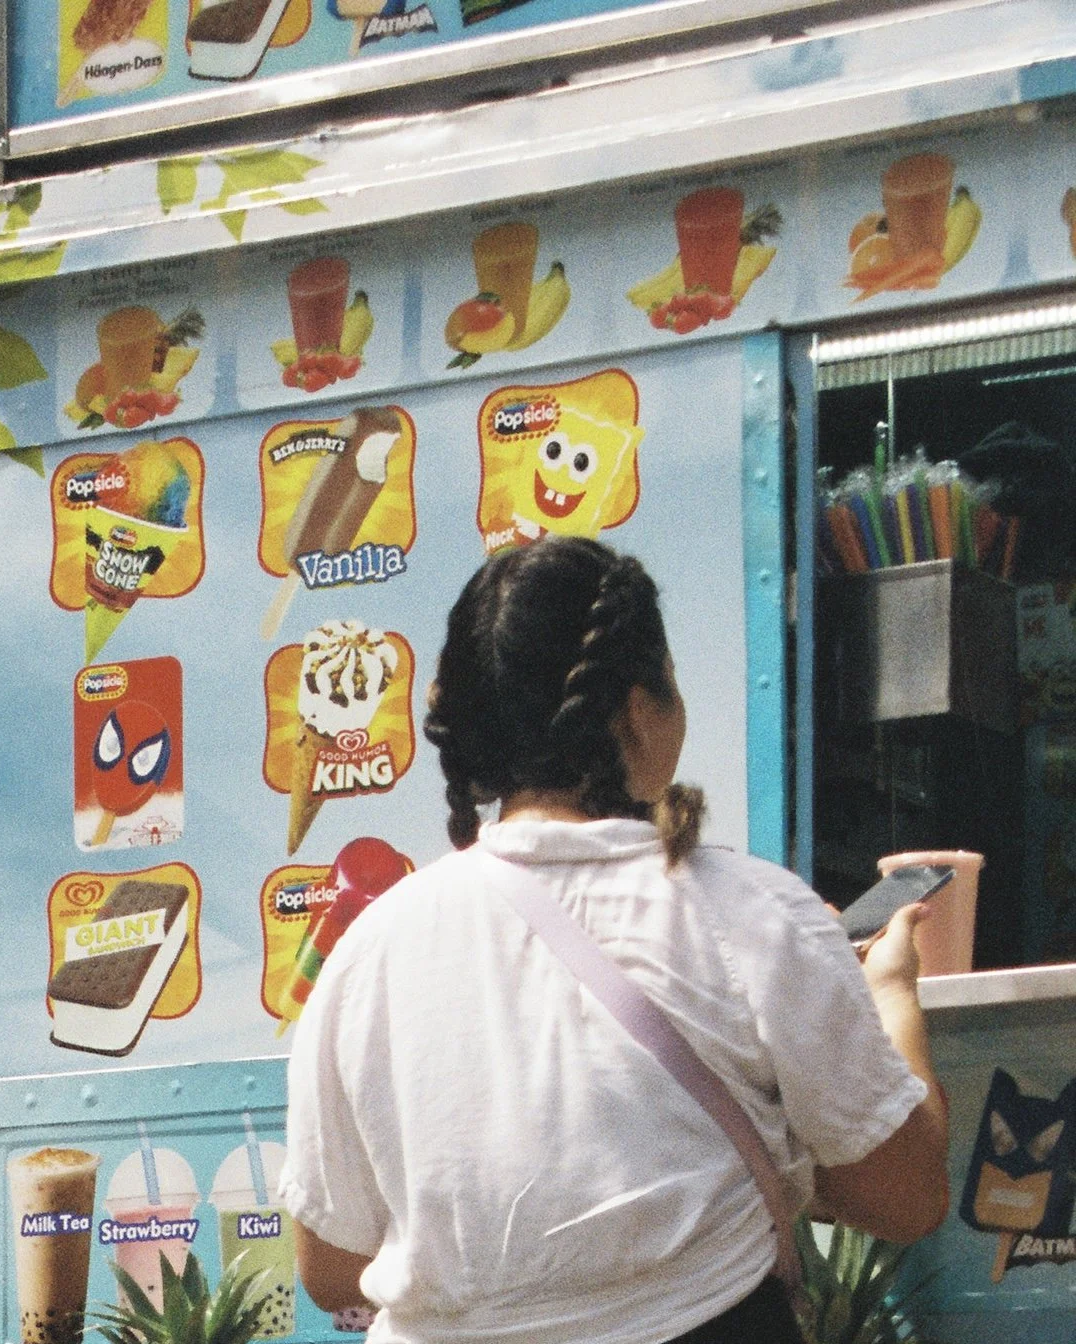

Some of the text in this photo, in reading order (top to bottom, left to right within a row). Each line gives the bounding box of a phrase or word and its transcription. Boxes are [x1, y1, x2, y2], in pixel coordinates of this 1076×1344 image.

[364, 7, 435, 37] BATMAN
[494, 404, 555, 430] Popsicle
[66, 473, 125, 497] Popsicle
[102, 541, 149, 574] SNOW
[297, 544, 405, 586] Vanilla
[96, 560, 141, 590] CONE
[319, 750, 348, 762] GOOD
[312, 755, 394, 794] KING
[75, 913, 160, 947] GIANT
[24, 1215, 90, 1233] Milk Tea
[101, 1219, 196, 1242] Strawberry
[240, 1216, 279, 1236] Kiwi
